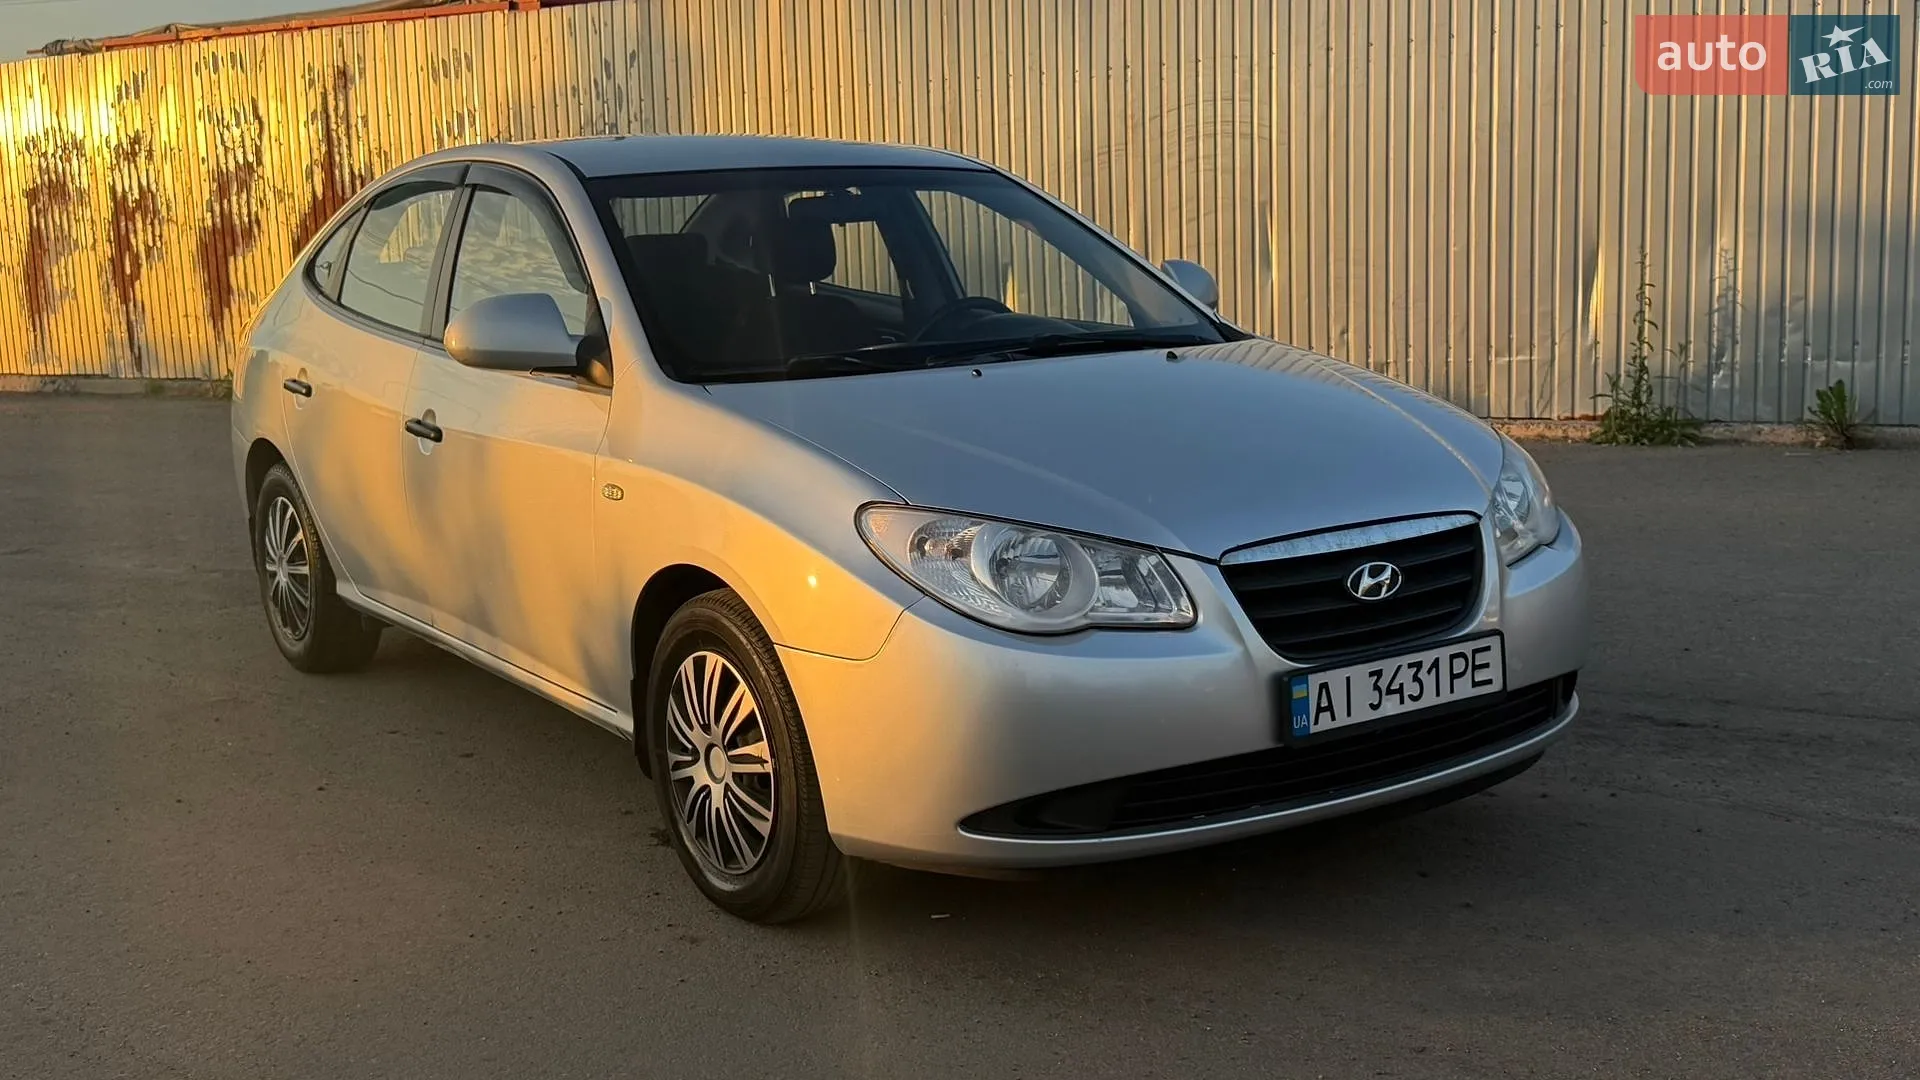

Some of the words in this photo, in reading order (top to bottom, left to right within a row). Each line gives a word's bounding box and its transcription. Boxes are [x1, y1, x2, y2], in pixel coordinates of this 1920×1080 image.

[1313, 676, 1352, 726] AI
[1368, 656, 1441, 711] 3431
[1293, 714, 1309, 729] UA
